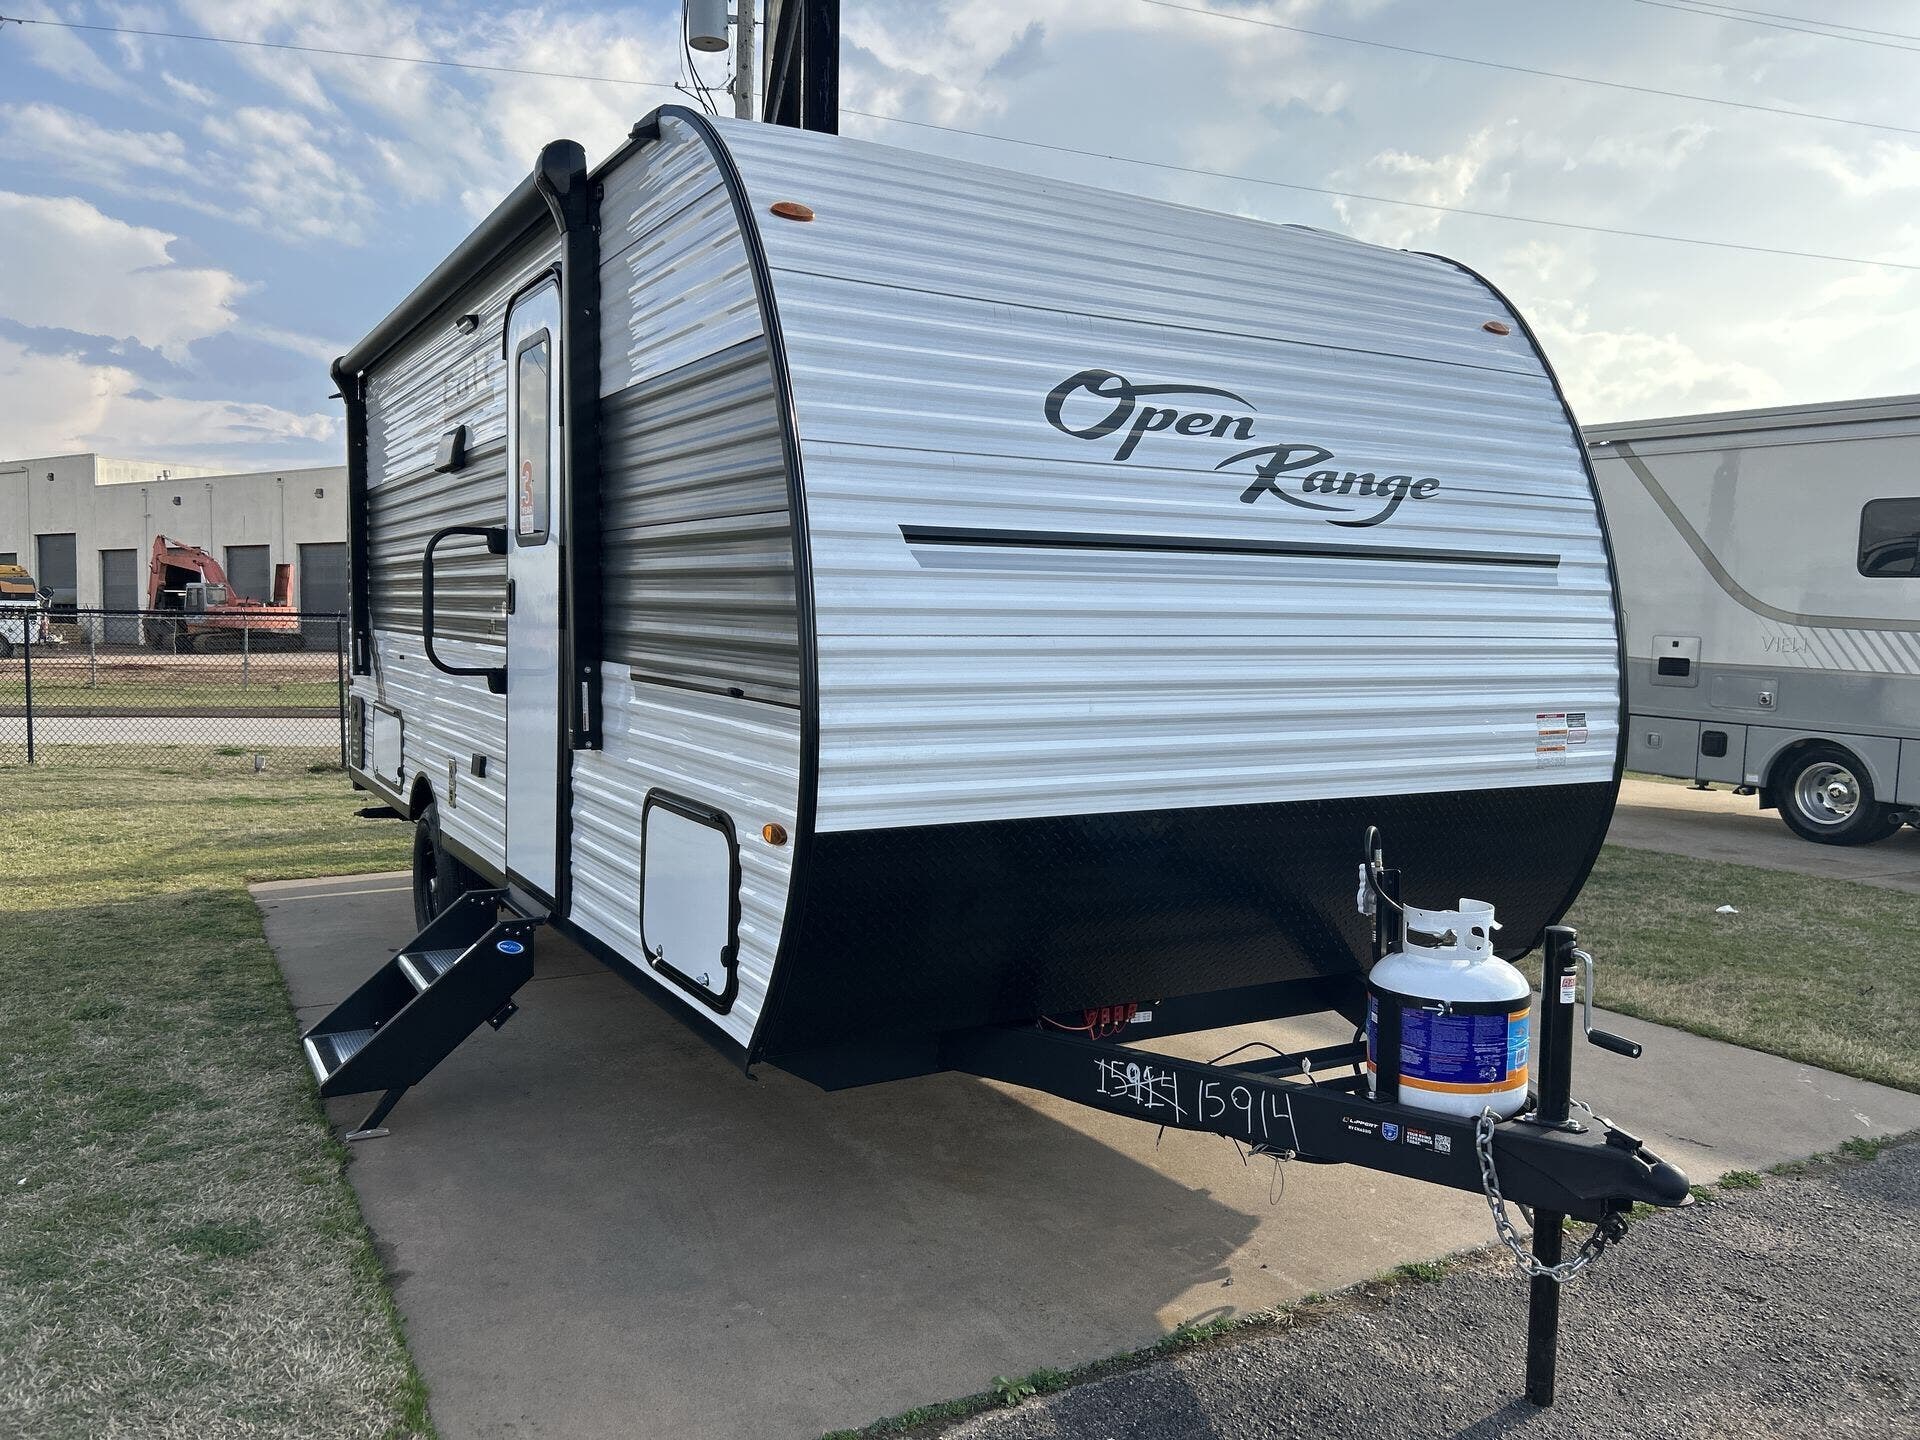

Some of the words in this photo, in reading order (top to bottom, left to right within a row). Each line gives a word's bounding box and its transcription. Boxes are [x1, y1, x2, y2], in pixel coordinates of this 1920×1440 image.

[1044, 369, 1257, 461] Open
[522, 460, 533, 507] 3
[1214, 443, 1440, 528] Range
[1761, 636, 1808, 653] VIEW
[1199, 1079, 1301, 1152] 15914
